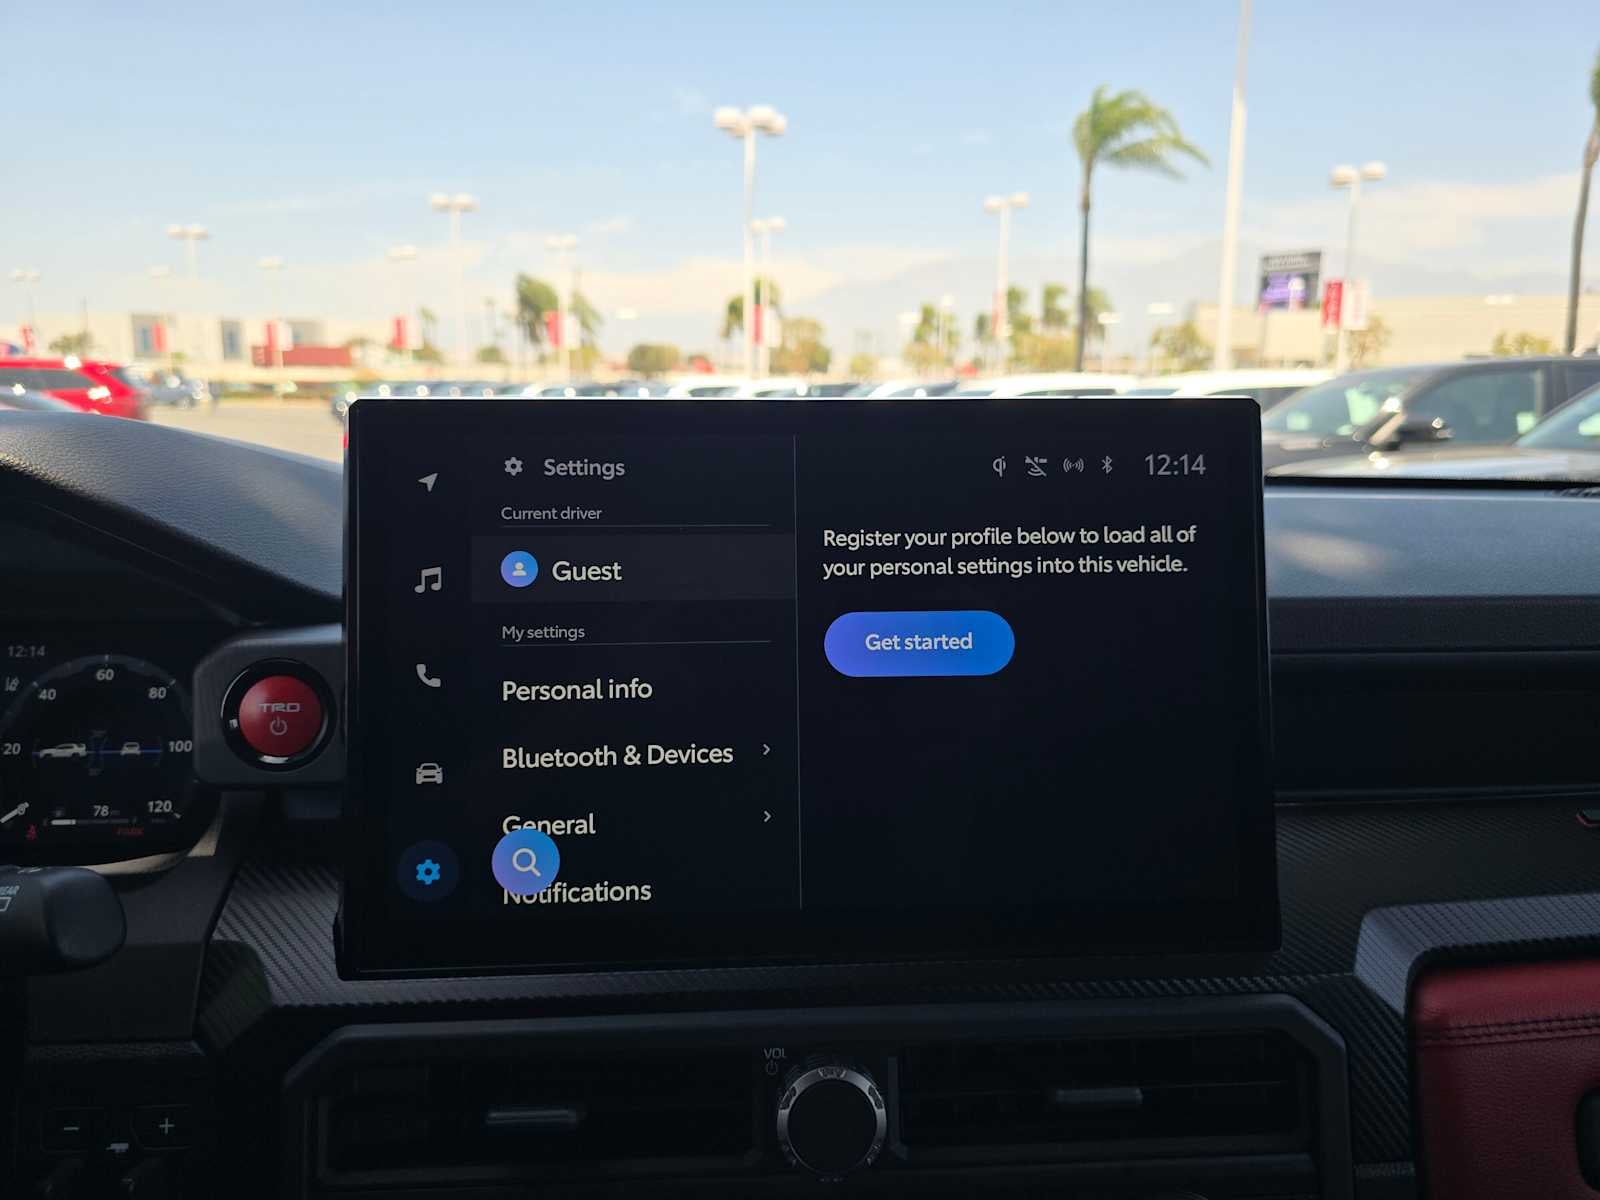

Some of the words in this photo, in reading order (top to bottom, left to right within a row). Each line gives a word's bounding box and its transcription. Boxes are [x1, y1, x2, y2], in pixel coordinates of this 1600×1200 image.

[543, 458, 626, 480] Settings
[1144, 453, 1207, 477] 12:14
[500, 506, 559, 521] Current
[560, 505, 603, 521] driver
[822, 527, 901, 550] Register
[903, 531, 948, 550] your
[951, 526, 1013, 548] profile
[1017, 525, 1076, 545] below
[1079, 527, 1099, 544] to
[1103, 525, 1146, 544] load
[1149, 524, 1175, 544] all
[1175, 524, 1198, 543] of
[551, 560, 623, 583] Guest
[822, 562, 865, 580] your
[869, 556, 954, 580] personal
[957, 556, 1034, 579] settings
[1036, 556, 1075, 574] into
[1077, 555, 1114, 573] this
[1115, 554, 1189, 573] vehicle.
[501, 625, 525, 643] My
[526, 624, 586, 642] settings
[864, 633, 901, 651] Get
[904, 631, 974, 650] started
[7, 645, 46, 658] 12:14
[96, 668, 115, 681] 60
[38, 688, 57, 700] 40
[148, 686, 167, 699] 80
[502, 678, 604, 702] Personal
[607, 677, 654, 699] info
[258, 702, 301, 713] TRD
[4, 742, 21, 755] 20
[168, 740, 193, 753] 100
[502, 744, 618, 770] Bluetooth
[623, 745, 642, 766] &
[646, 743, 735, 766] Devices
[93, 804, 110, 817] 78
[147, 799, 173, 813] 120
[502, 813, 597, 836] General
[763, 1047, 787, 1059] VOL
